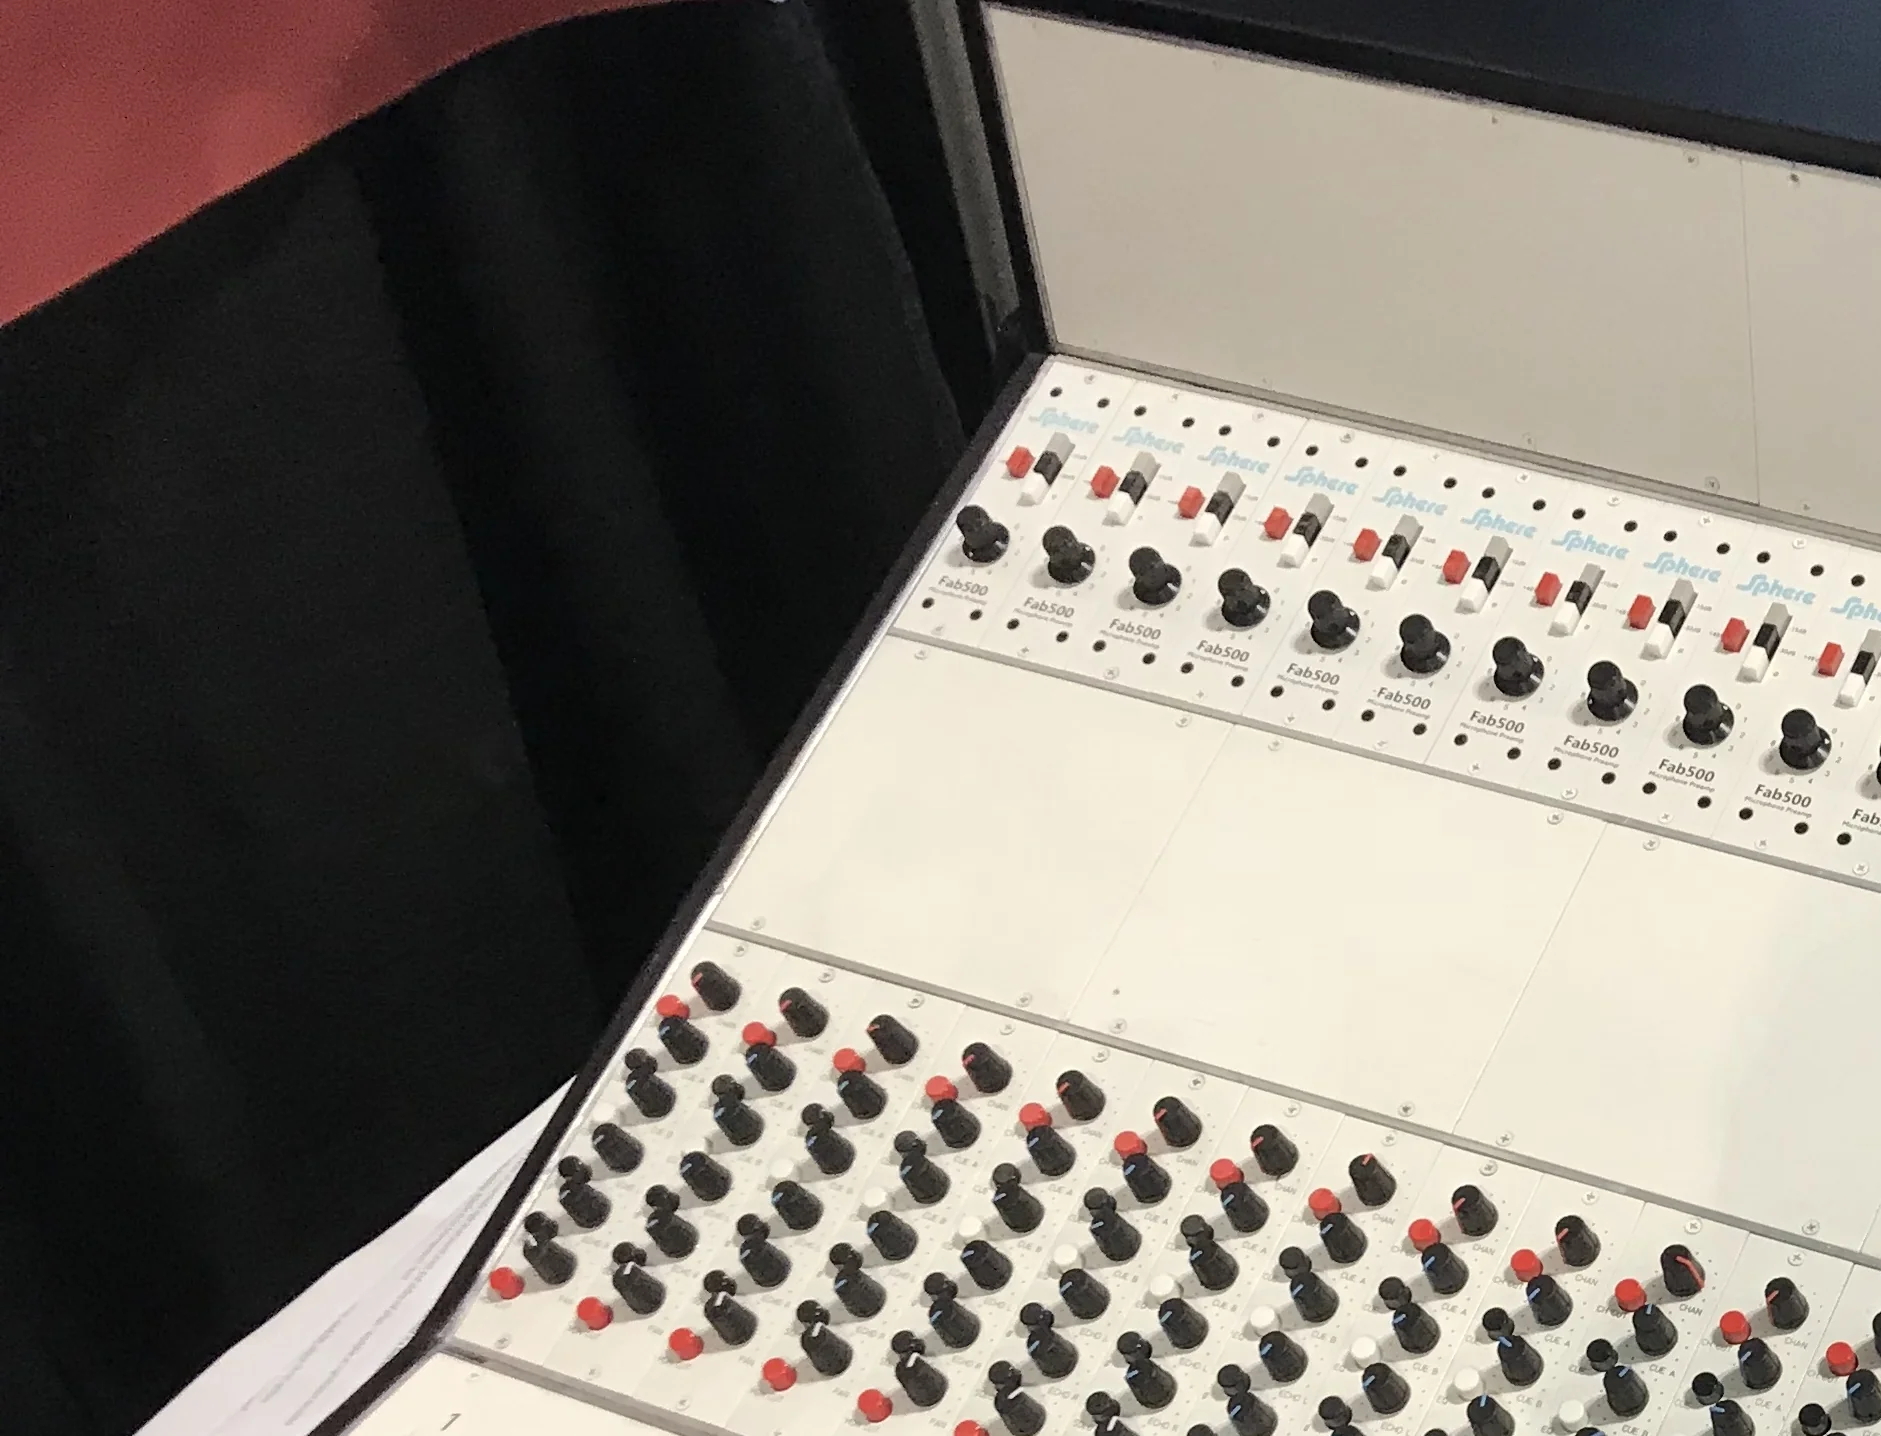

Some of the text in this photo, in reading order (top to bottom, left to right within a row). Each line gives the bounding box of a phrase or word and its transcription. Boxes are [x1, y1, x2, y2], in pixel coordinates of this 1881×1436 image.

[1029, 407, 1099, 434] Sphere
[1112, 426, 1185, 456] Sphere
[1197, 445, 1270, 476] Sphere
[1283, 466, 1358, 497] Sphere
[1371, 485, 1447, 517] Sphere
[1460, 509, 1538, 539] Sphere
[1551, 529, 1630, 561] Sphere
[1644, 551, 1722, 584] Sphere
[937, 574, 989, 597] Fab500
[1736, 573, 1816, 605] Sphere
[1023, 596, 1075, 619] Fab500
[1109, 617, 1162, 640] Fab500
[1197, 640, 1250, 663] Fab500
[1286, 661, 1341, 686] Fab500
[1376, 685, 1432, 710] Fab500
[1469, 710, 1525, 734] Fab500
[1563, 734, 1620, 759] Fab500
[1658, 759, 1715, 784] Fab500
[1754, 783, 1812, 809] Fab500
[441, 1413, 461, 1431] 1
